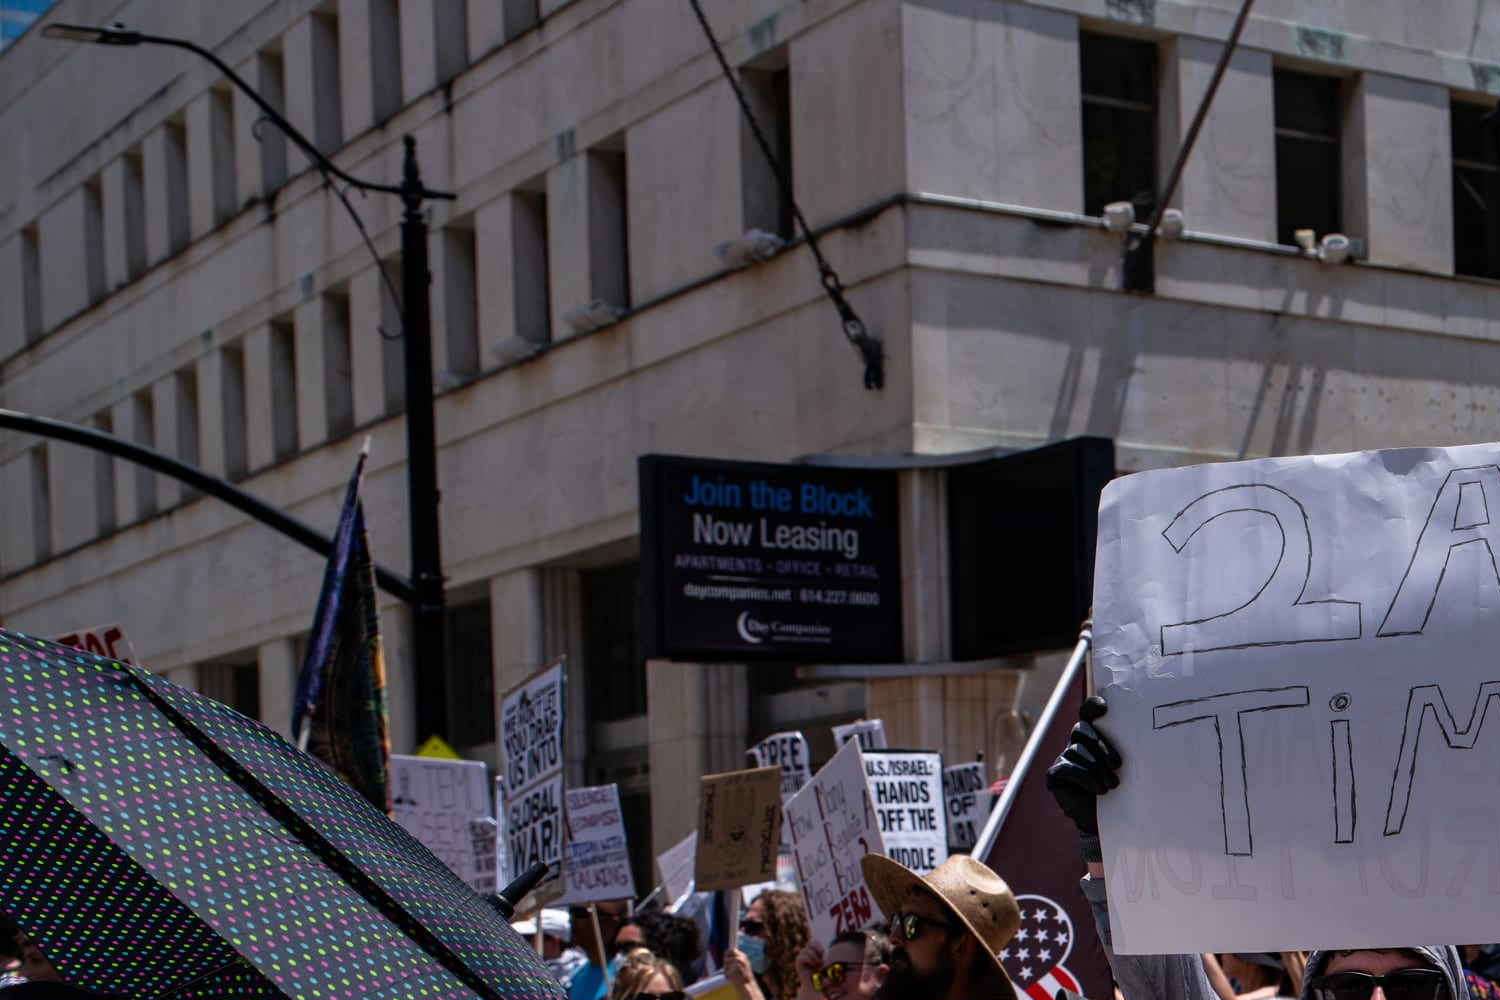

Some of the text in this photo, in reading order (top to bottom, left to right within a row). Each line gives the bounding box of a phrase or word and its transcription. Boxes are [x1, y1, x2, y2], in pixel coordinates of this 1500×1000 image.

[682, 472, 874, 518] Join the Block
[693, 512, 859, 560] Now Leasing
[674, 553, 763, 574] APARTMENTS
[505, 731, 527, 757] YOU
[759, 738, 804, 772] FREE
[508, 735, 558, 791] US INTO
[509, 782, 558, 835] GLOBAL
[876, 781, 930, 804] HANDS
[908, 808, 937, 830] THE
